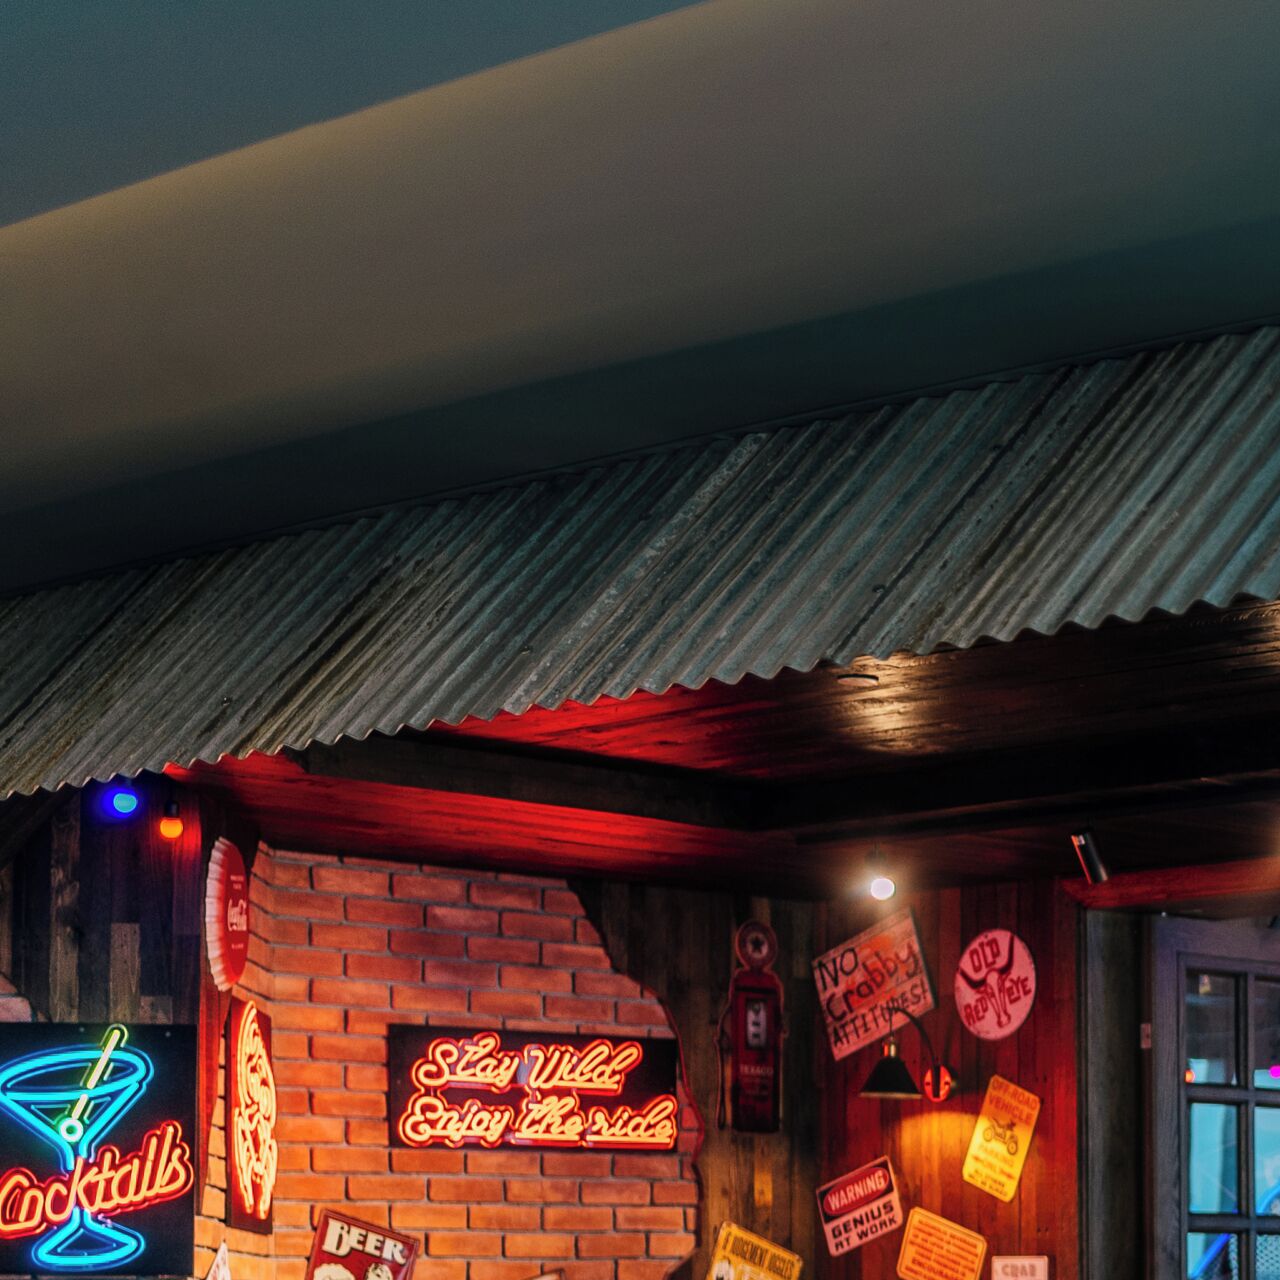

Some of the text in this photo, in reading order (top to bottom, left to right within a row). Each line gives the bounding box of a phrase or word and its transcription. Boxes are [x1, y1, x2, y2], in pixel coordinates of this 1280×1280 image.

[816, 947, 861, 992] NO
[969, 934, 1000, 972] OLD
[825, 939, 920, 1023] Crabby
[963, 976, 1033, 1026] RED EYE
[416, 1034, 641, 1092] Stay Wild
[402, 1090, 515, 1144] Enjoy
[585, 1097, 675, 1146] ride
[827, 1169, 886, 1211] WARNING
[319, 1217, 409, 1265] BEER
[830, 1200, 895, 1241] GENIUS
[855, 1215, 898, 1242] WORK
